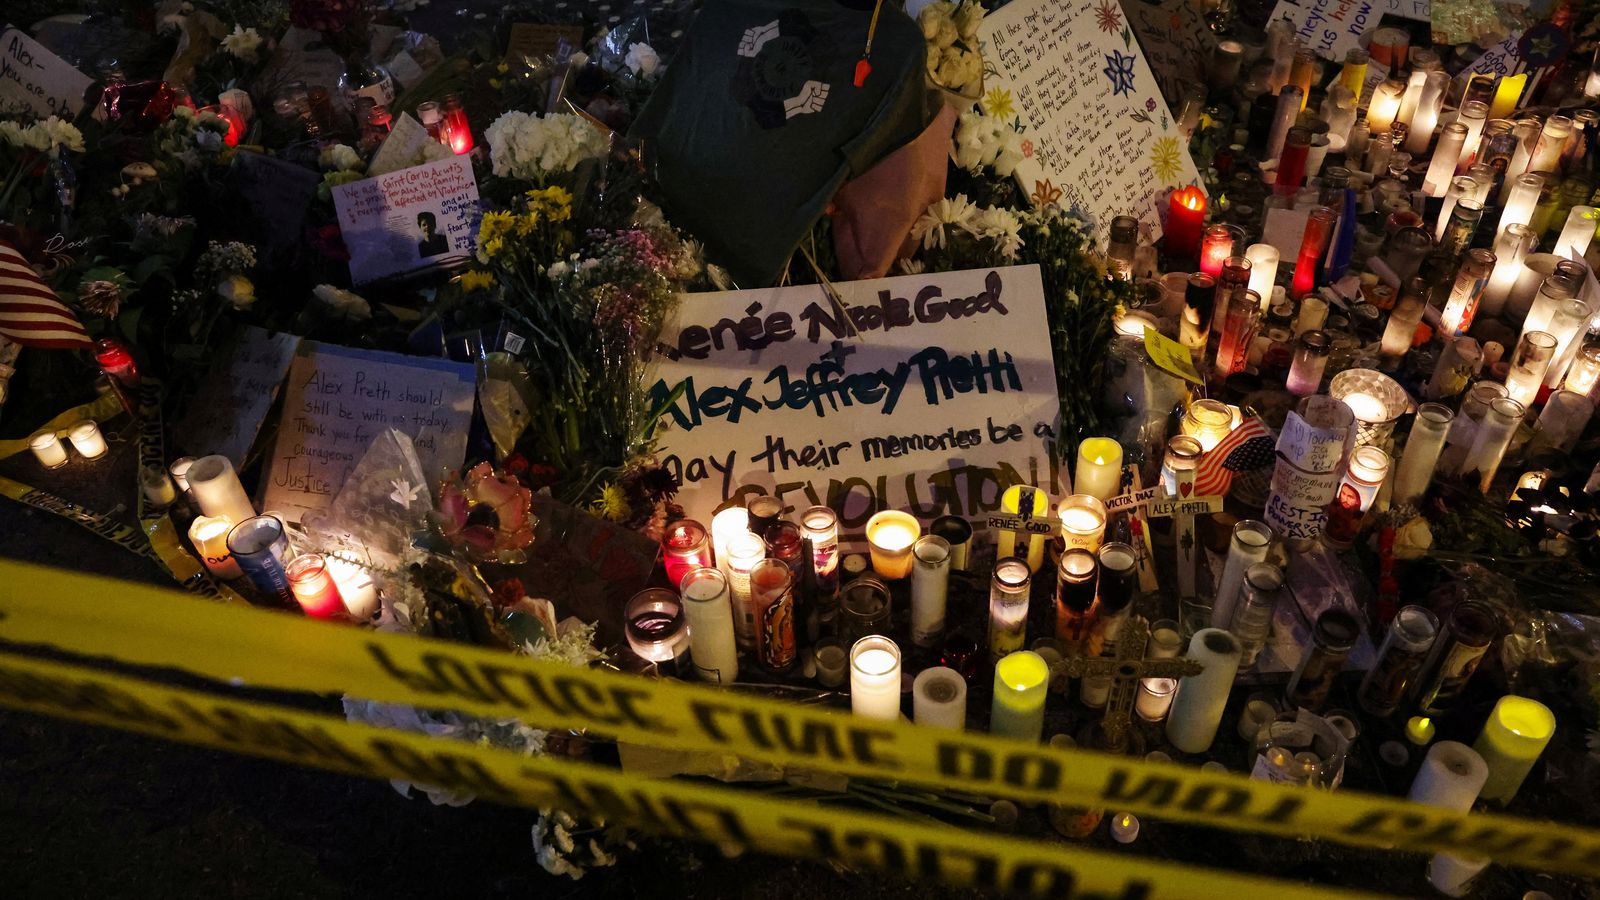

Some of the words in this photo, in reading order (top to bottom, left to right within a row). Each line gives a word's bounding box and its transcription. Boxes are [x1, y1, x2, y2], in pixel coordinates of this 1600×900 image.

[992, 29, 1006, 51] All
[1006, 23, 1021, 37] these
[1024, 7, 1040, 28] people
[999, 47, 1017, 61] Going
[1027, 24, 1040, 39] with
[1042, 13, 1056, 26] their
[1059, 1, 1072, 13] lives
[1023, 43, 1037, 55] they
[1051, 13, 1072, 35] murdered
[1080, 2, 1092, 13] man
[1347, 2, 1372, 36] now
[1019, 60, 1032, 73] front
[1048, 40, 1058, 50] my
[1059, 27, 1072, 43] eyes
[1318, 28, 1338, 51] us
[1499, 40, 1521, 61] ALEX
[1017, 84, 1031, 102] Will
[1035, 65, 1062, 87] somebody
[1062, 51, 1074, 64] tell
[1076, 41, 1092, 53] them
[1484, 52, 1508, 75] GOOD
[1497, 53, 1506, 61] A
[26, 83, 44, 97] are
[1022, 97, 1034, 112] Will
[1037, 87, 1051, 100] they
[1079, 48, 1101, 67] someday
[1028, 106, 1041, 123] Will
[1042, 99, 1056, 111] they
[1055, 89, 1066, 100] also
[1068, 76, 1077, 89] get
[1087, 62, 1097, 72] see
[1032, 115, 1046, 131] What
[1082, 72, 1099, 88] today
[1045, 145, 1057, 160] And
[1095, 103, 1106, 112] too
[1050, 153, 1062, 168] Will
[1064, 144, 1074, 154] the
[1076, 128, 1092, 142] video
[1073, 145, 1086, 158] more
[1088, 130, 1101, 144] than
[1104, 120, 1113, 129] one
[1115, 106, 1129, 118] view
[1136, 126, 1152, 146] world
[1079, 168, 1089, 181] any
[1098, 144, 1113, 157] them
[1092, 160, 1104, 177] could
[1107, 153, 1116, 161] be
[1118, 137, 1134, 151] them
[1105, 179, 1112, 187] to
[1129, 147, 1145, 164] death
[343, 185, 359, 199] We
[382, 177, 404, 193] Saint
[405, 170, 429, 185] Carlo
[355, 199, 365, 208] to
[366, 193, 387, 207] pray
[420, 181, 432, 191] his
[1123, 182, 1135, 193] show
[1138, 165, 1152, 178] them
[1139, 188, 1155, 203] video
[394, 195, 427, 208] affected
[427, 188, 437, 200] by
[441, 198, 457, 208] and
[458, 193, 469, 202] all
[441, 205, 457, 216] who
[914, 271, 1009, 324] Good
[302, 369, 343, 395] Alex
[398, 388, 443, 406] should
[643, 376, 762, 440] Alex
[762, 354, 910, 418] Jeffrey
[294, 417, 327, 437] Thank
[333, 430, 351, 446] you
[353, 425, 370, 442] for
[302, 399, 329, 417] still
[338, 405, 354, 420] be
[362, 408, 388, 423] with
[412, 412, 449, 432] today
[751, 435, 852, 473] their
[861, 427, 982, 463] memories
[985, 417, 1025, 444] be
[1033, 422, 1058, 440] a
[275, 456, 331, 494] Justice
[1105, 496, 1133, 511] VICTOR
[1152, 503, 1177, 515] ALEX
[1181, 501, 1210, 514] PRETTI
[1268, 505, 1302, 530] POWER
[1272, 495, 1309, 520] REST
[988, 517, 1019, 531] RENÉE
[1025, 520, 1051, 534] GOOD
